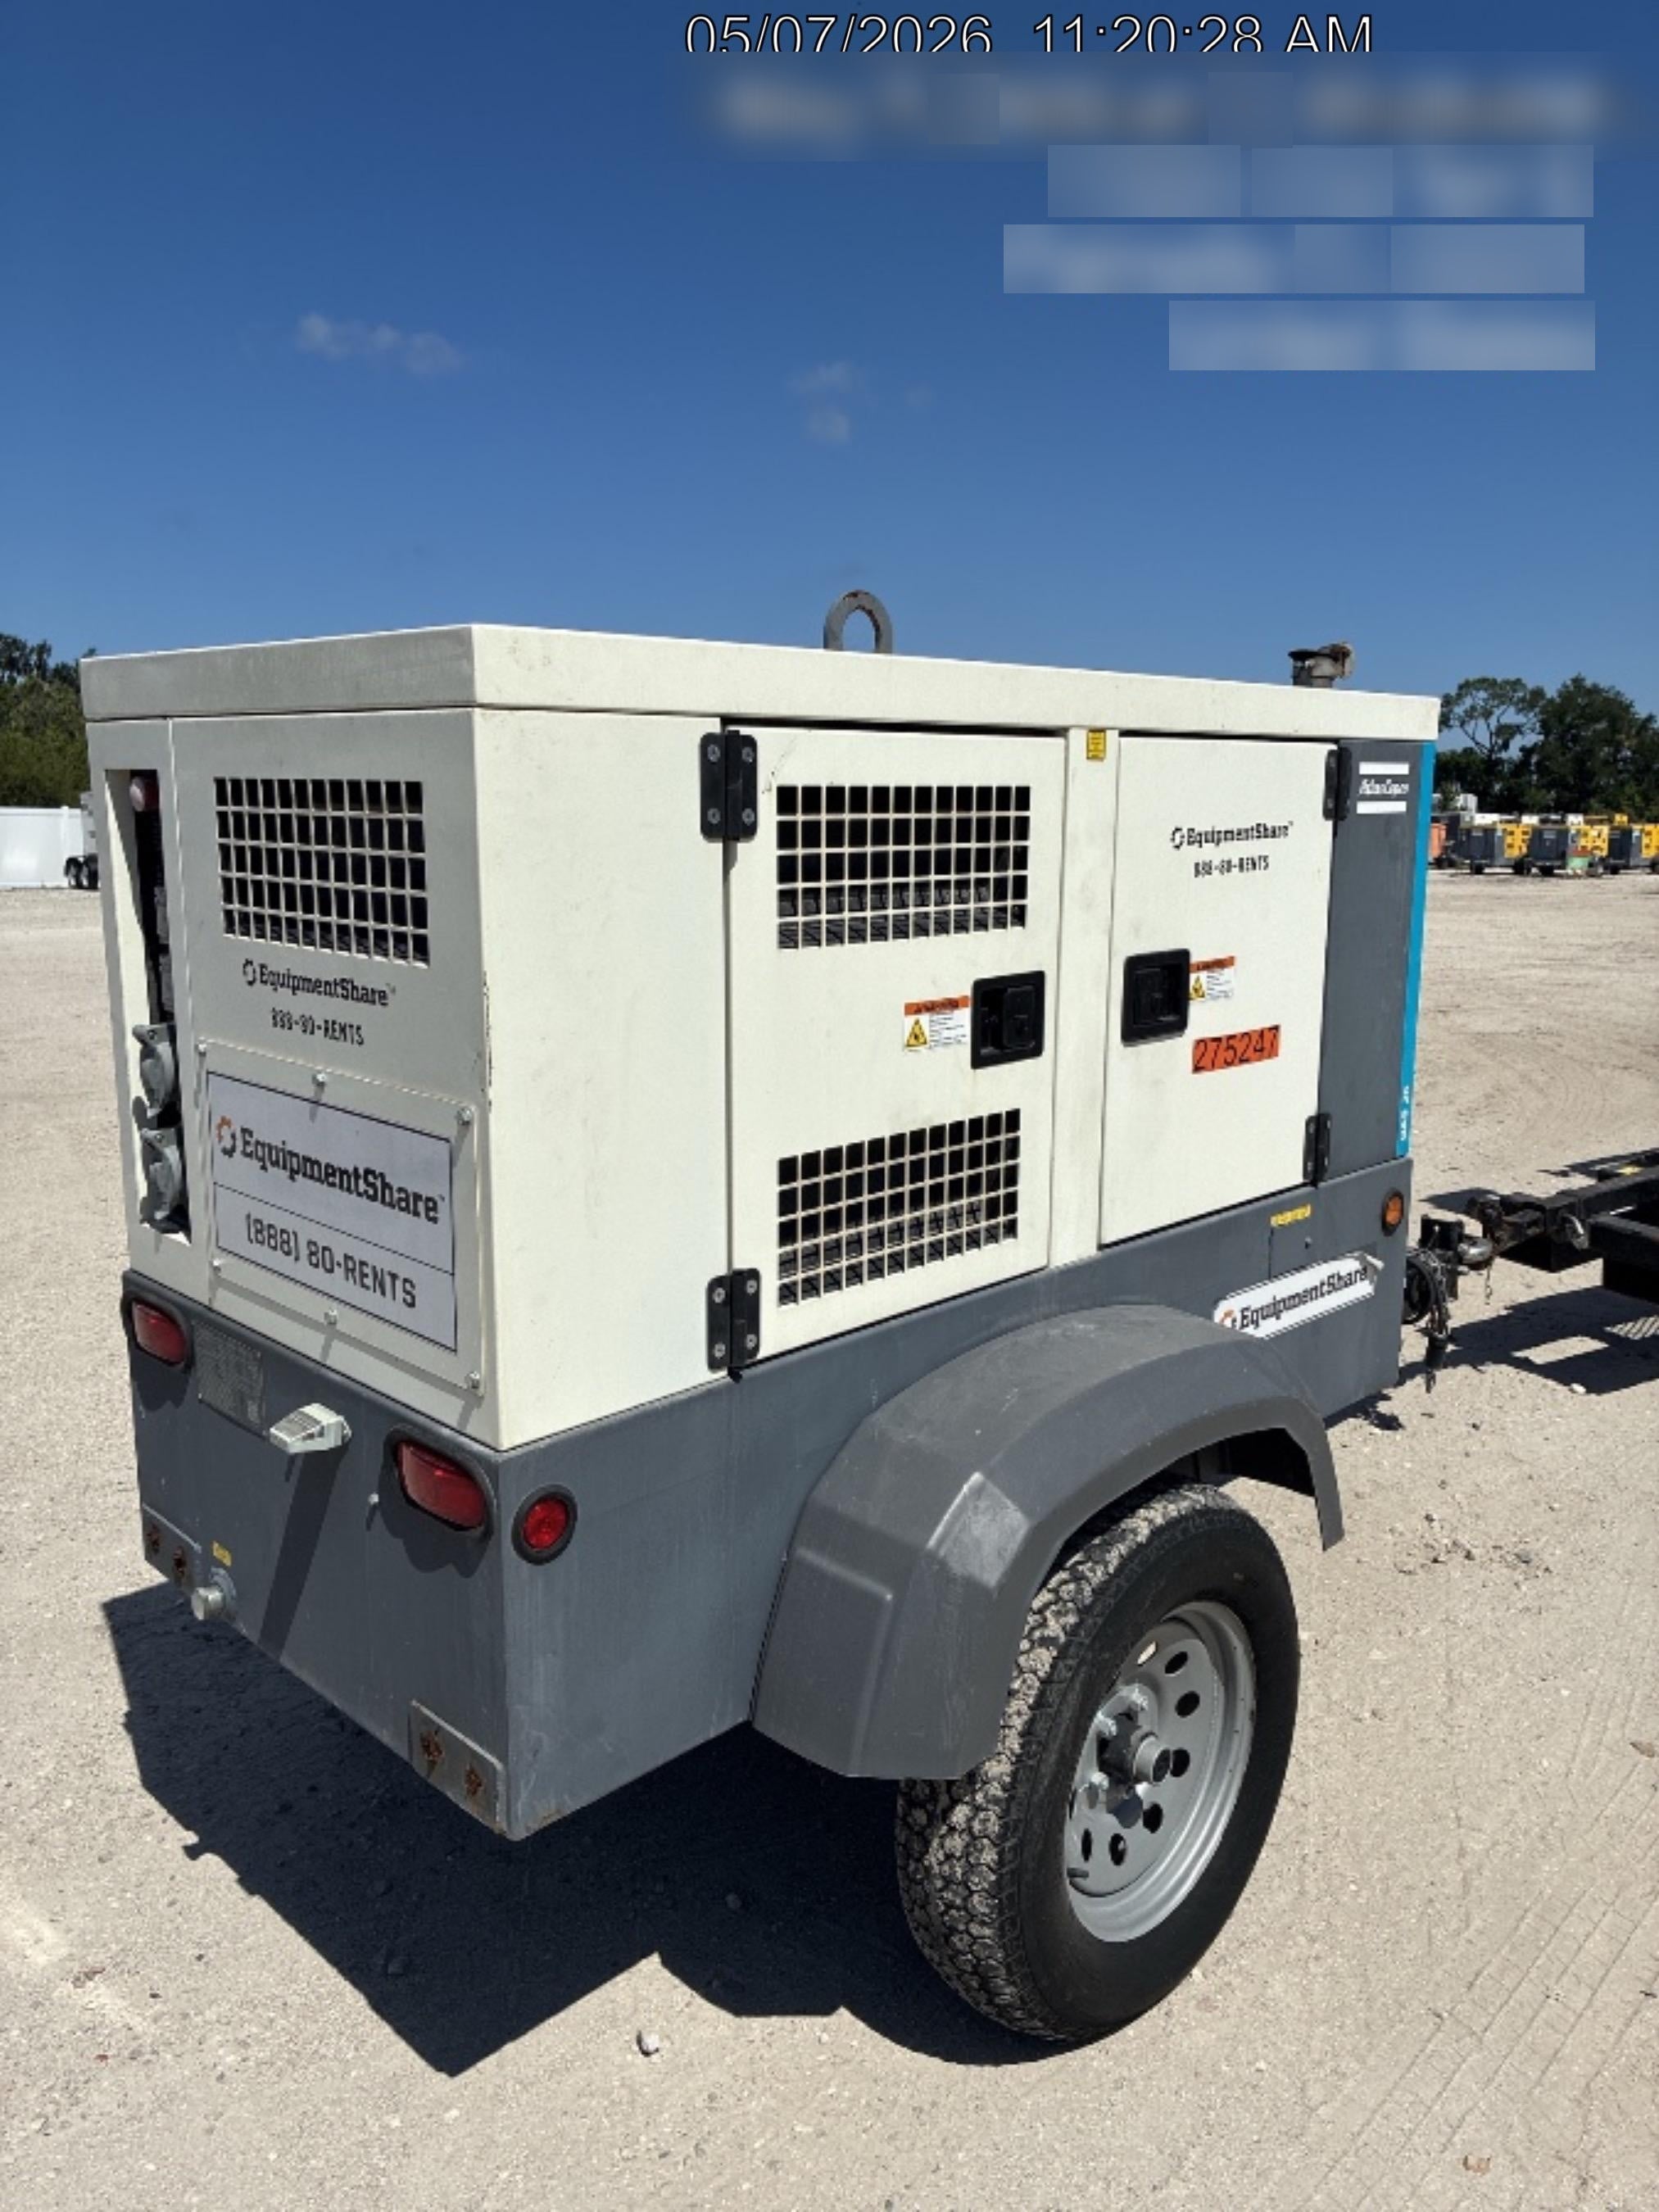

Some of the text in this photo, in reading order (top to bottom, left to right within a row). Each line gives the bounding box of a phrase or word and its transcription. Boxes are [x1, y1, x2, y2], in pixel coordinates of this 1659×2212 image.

[1193, 1026, 1280, 1072] 275247
[240, 1126, 439, 1224] EquipmentShare
[246, 1213, 415, 1308] (888) 80-RENTS
[1240, 1267, 1367, 1330] EquipmentShare
